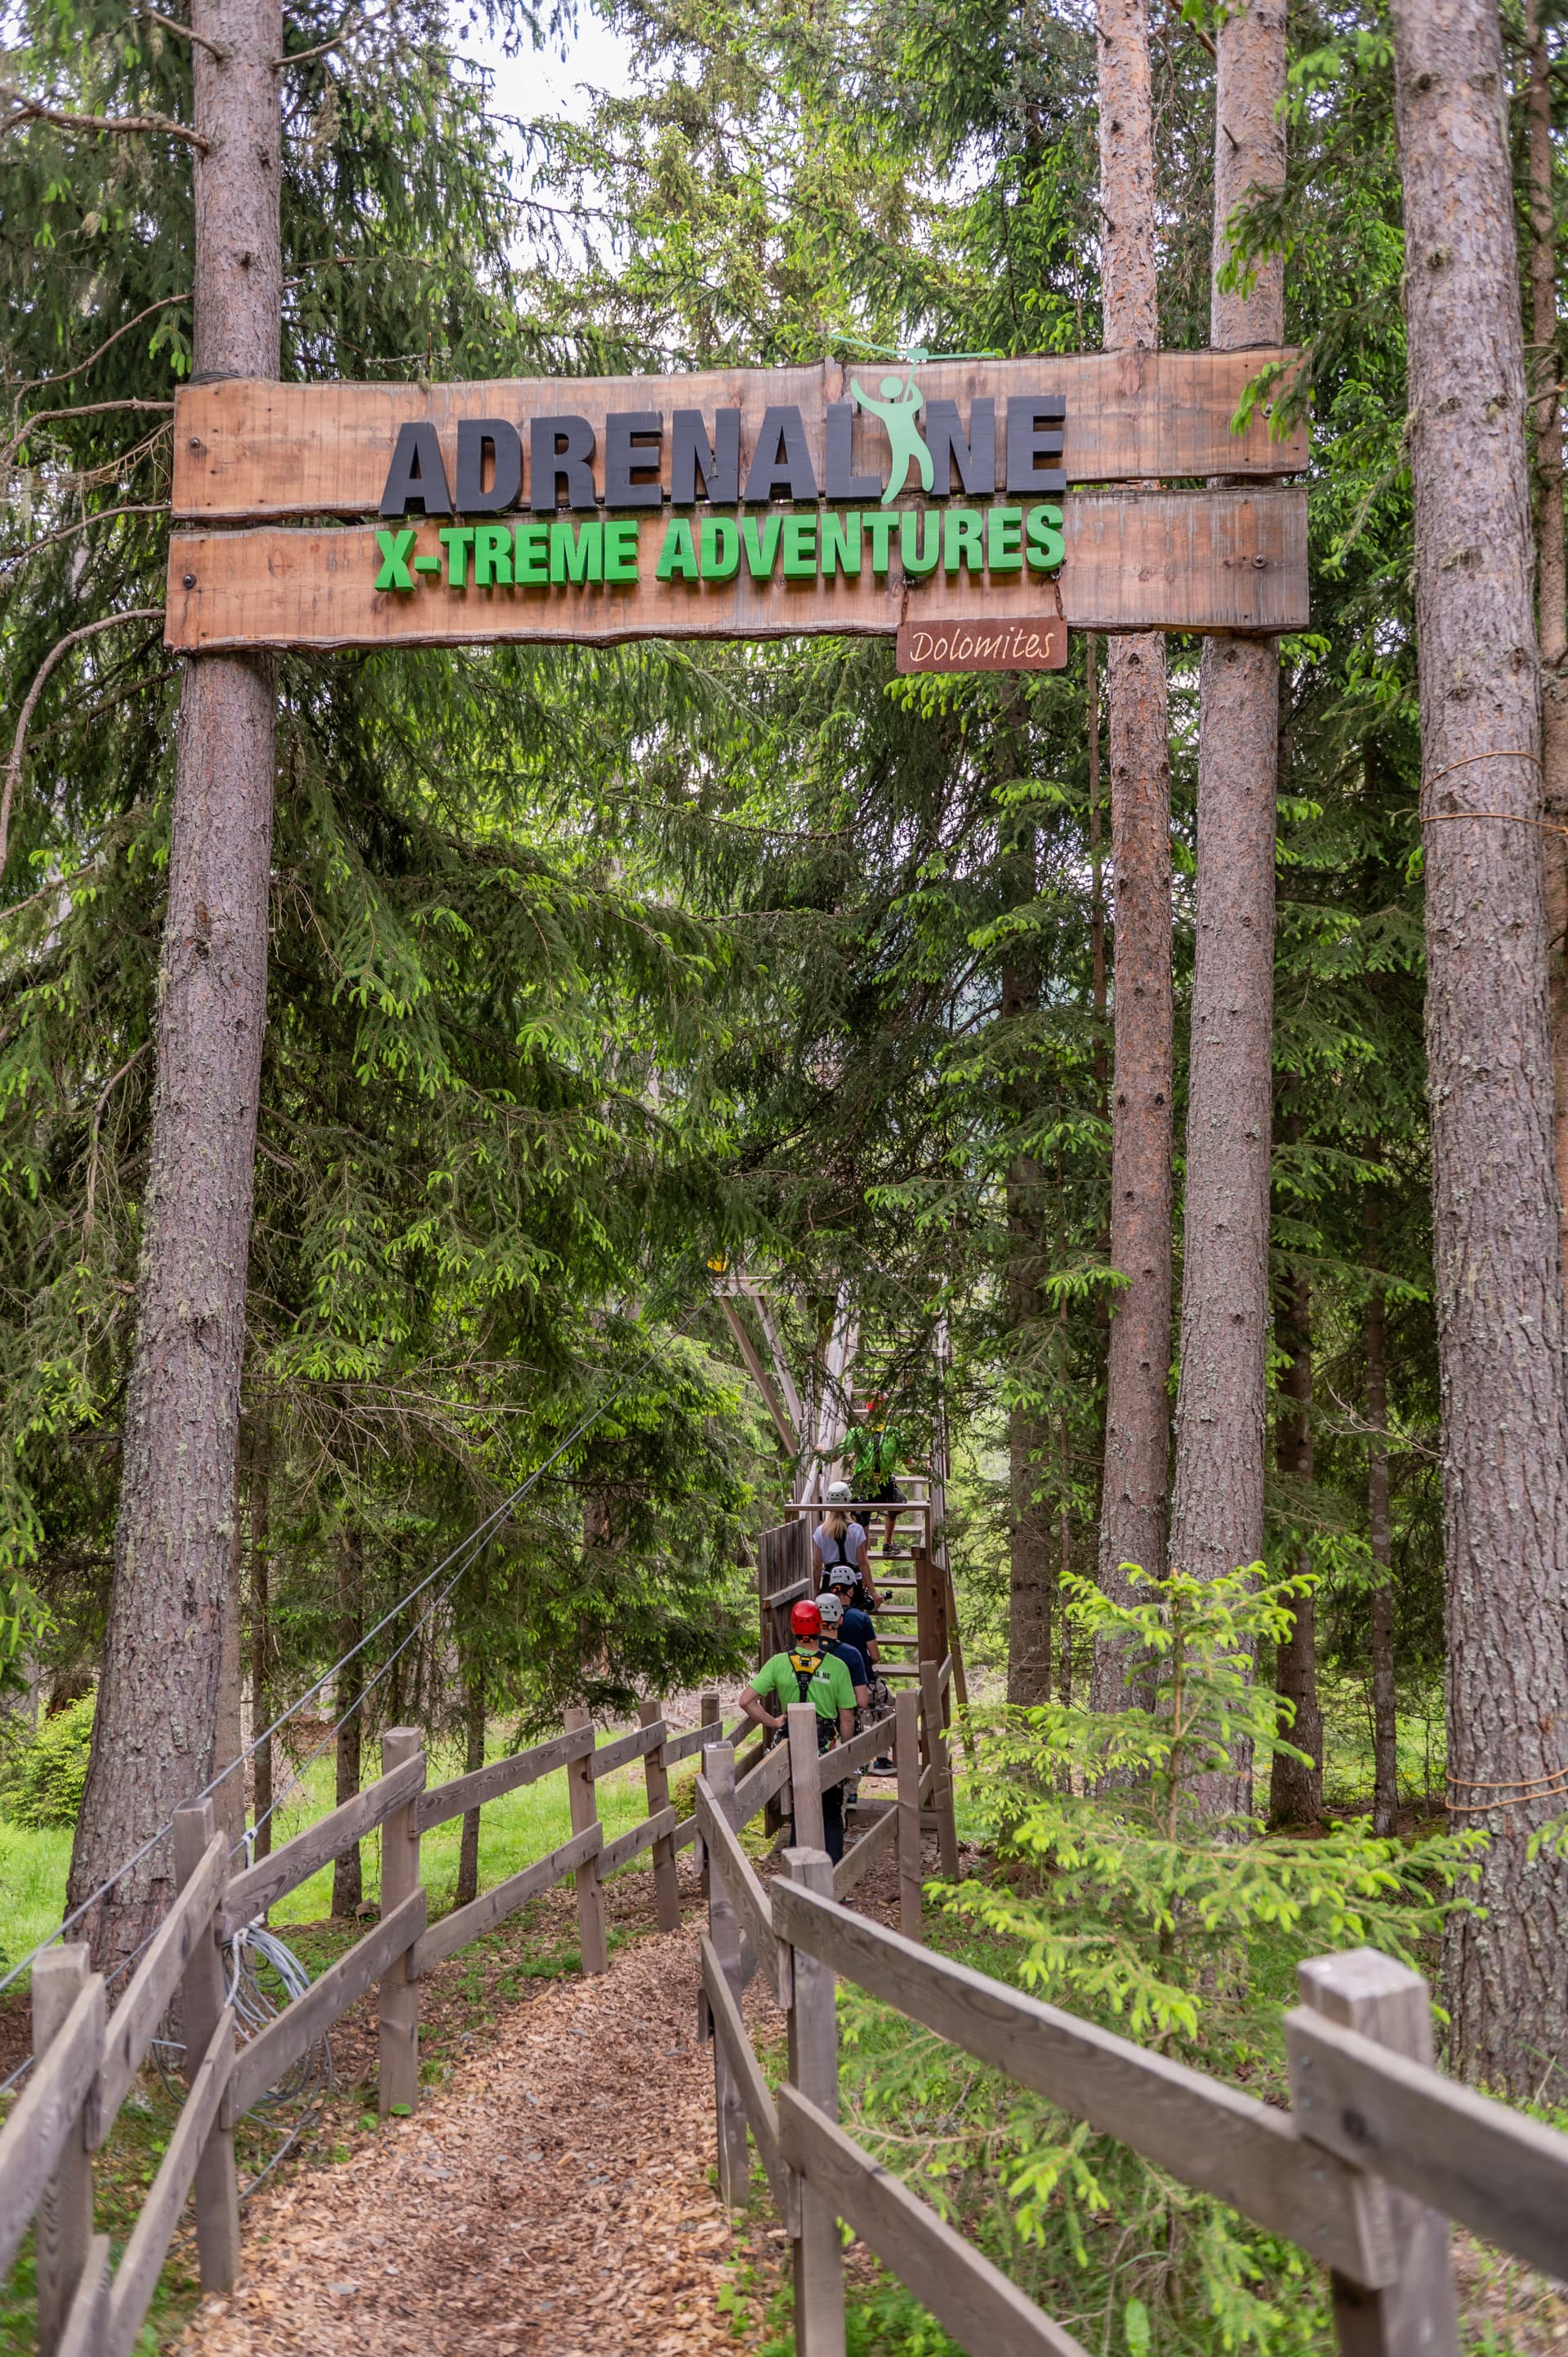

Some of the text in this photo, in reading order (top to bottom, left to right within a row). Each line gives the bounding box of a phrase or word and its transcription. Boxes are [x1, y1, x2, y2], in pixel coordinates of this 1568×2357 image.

[373, 505, 1067, 593] X-TREME ADVENTURES
[910, 626, 1055, 662] Dolomites
